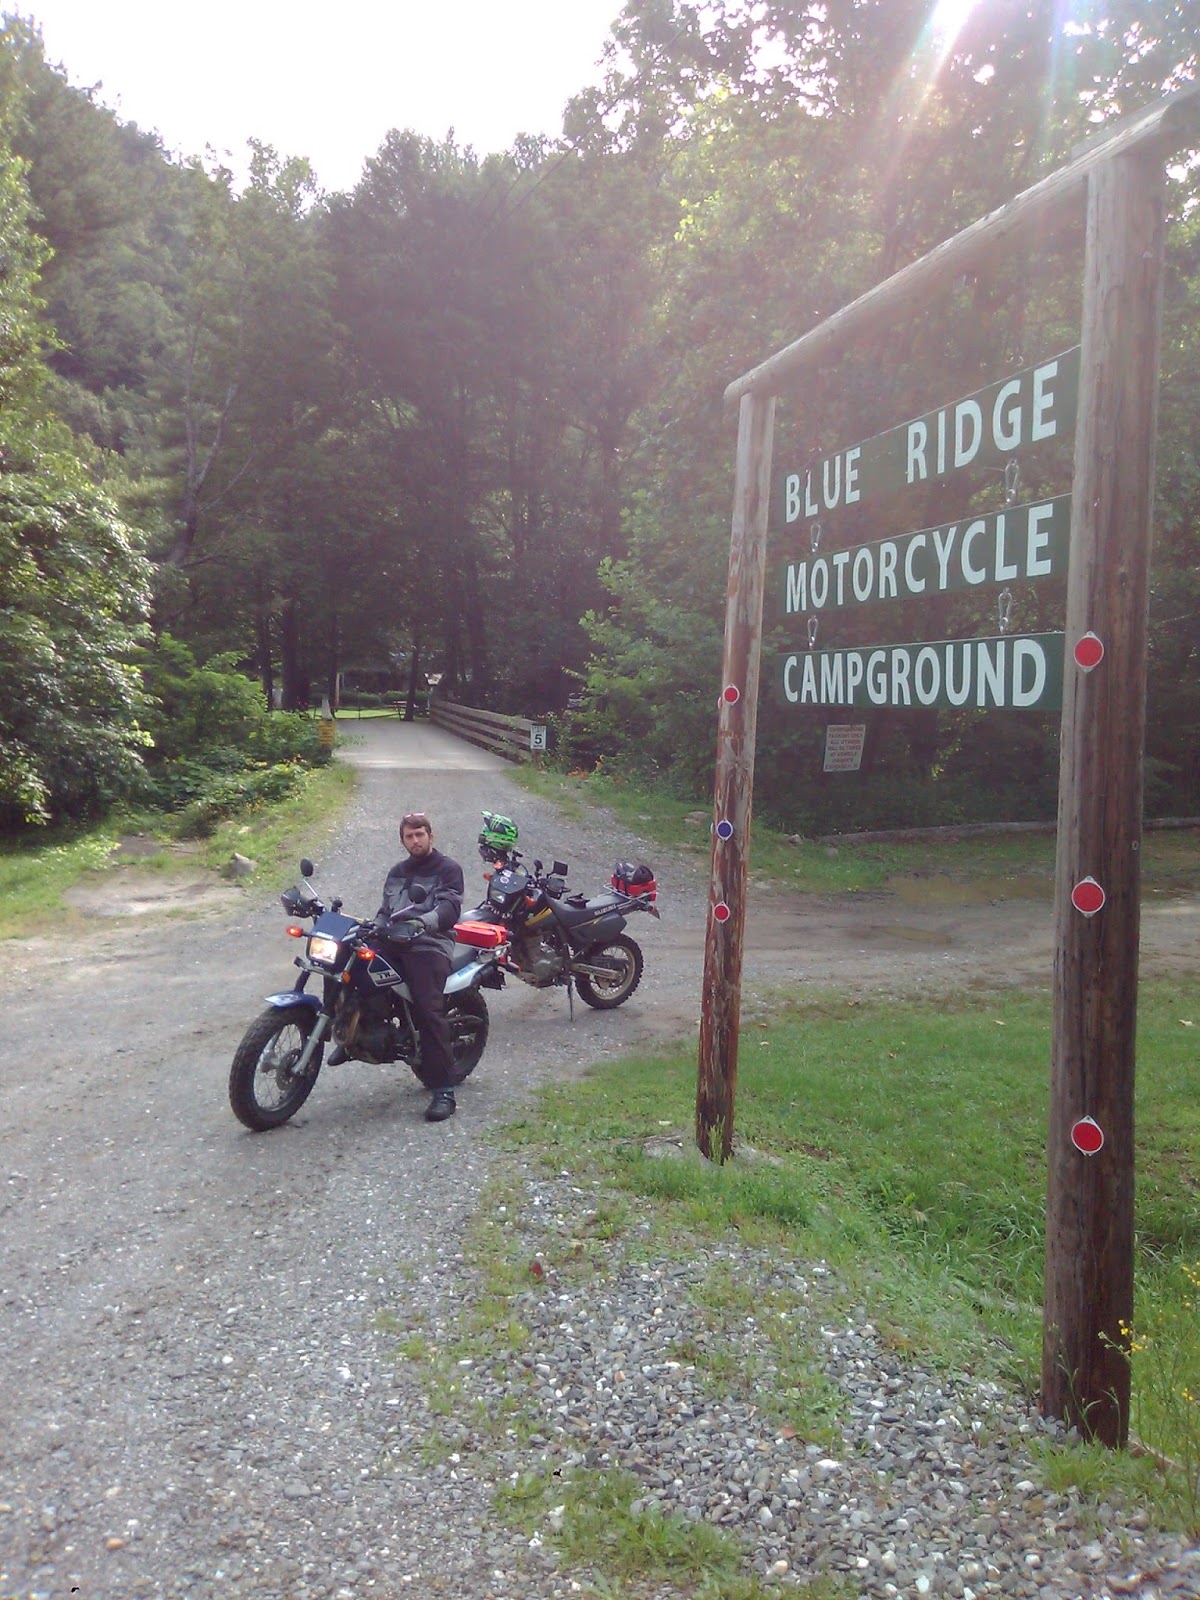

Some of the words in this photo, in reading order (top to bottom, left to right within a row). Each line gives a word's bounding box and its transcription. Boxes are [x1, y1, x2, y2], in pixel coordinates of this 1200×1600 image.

[785, 447, 861, 523] BLUE
[905, 360, 1059, 483] RIDGE
[785, 503, 1054, 613] MOTORCYCLE
[783, 638, 1047, 708] CAMPGROUND
[534, 734, 542, 745] 5
